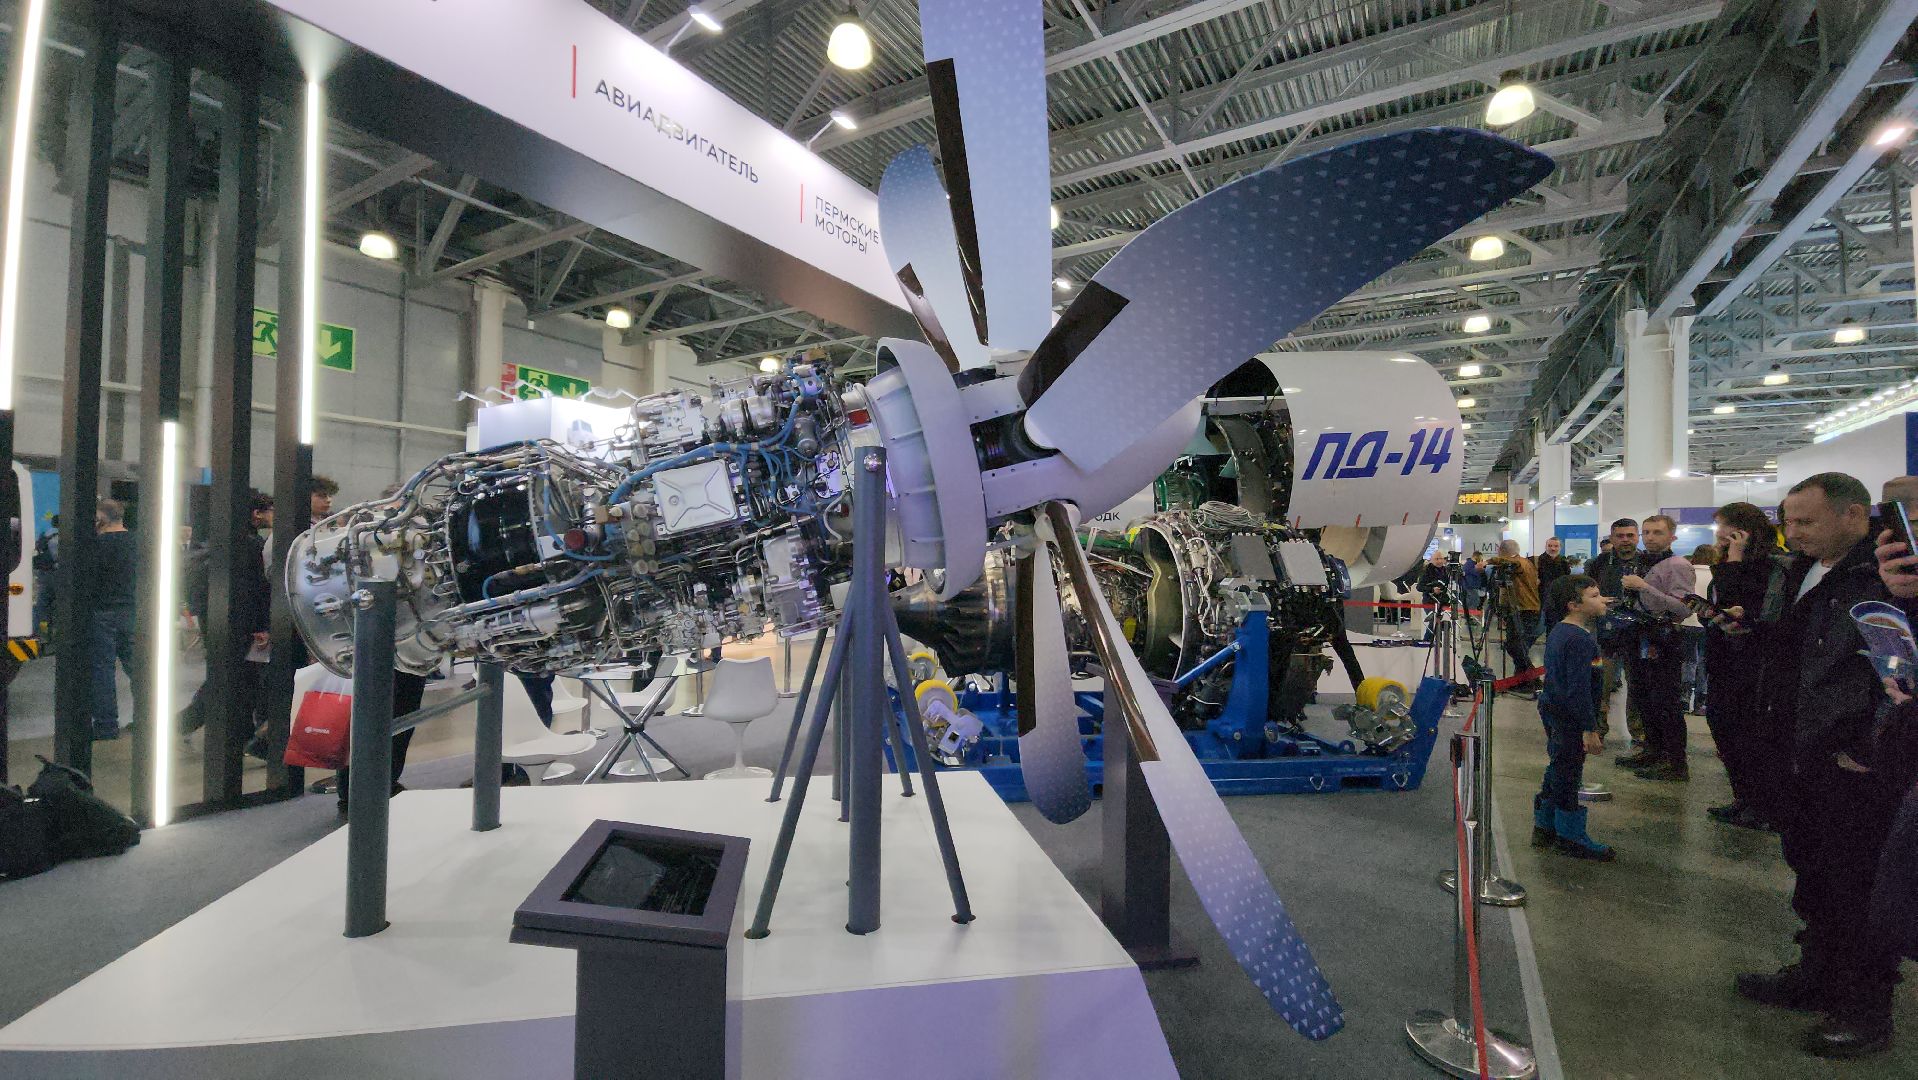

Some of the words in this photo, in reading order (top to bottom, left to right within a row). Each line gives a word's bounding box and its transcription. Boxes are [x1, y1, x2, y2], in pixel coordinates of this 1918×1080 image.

[595, 79, 759, 184] АВИАДВИГАТЕЛЬ
[815, 195, 879, 244] ПЕРМСКИЕ
[815, 214, 868, 255] МОТОРЫ
[1301, 427, 1455, 481] ПД-14
